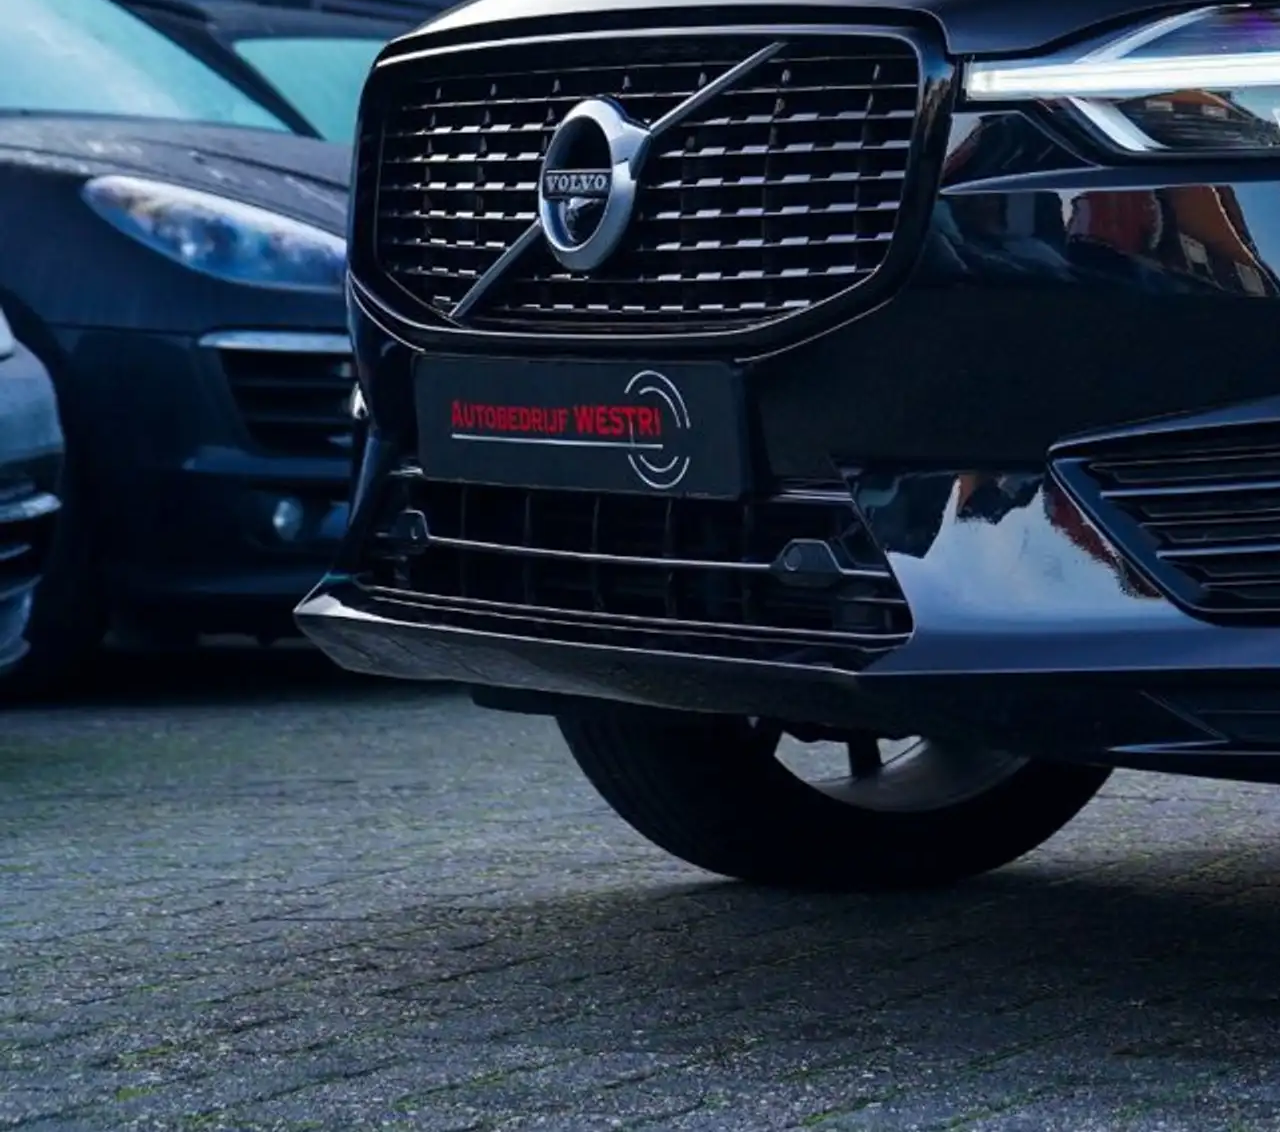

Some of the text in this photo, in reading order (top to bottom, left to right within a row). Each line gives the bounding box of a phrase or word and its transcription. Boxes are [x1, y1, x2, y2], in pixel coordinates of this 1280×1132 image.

[546, 174, 608, 190] VOLVO
[451, 401, 662, 437] AUTOBEDRIJF WESTRI
